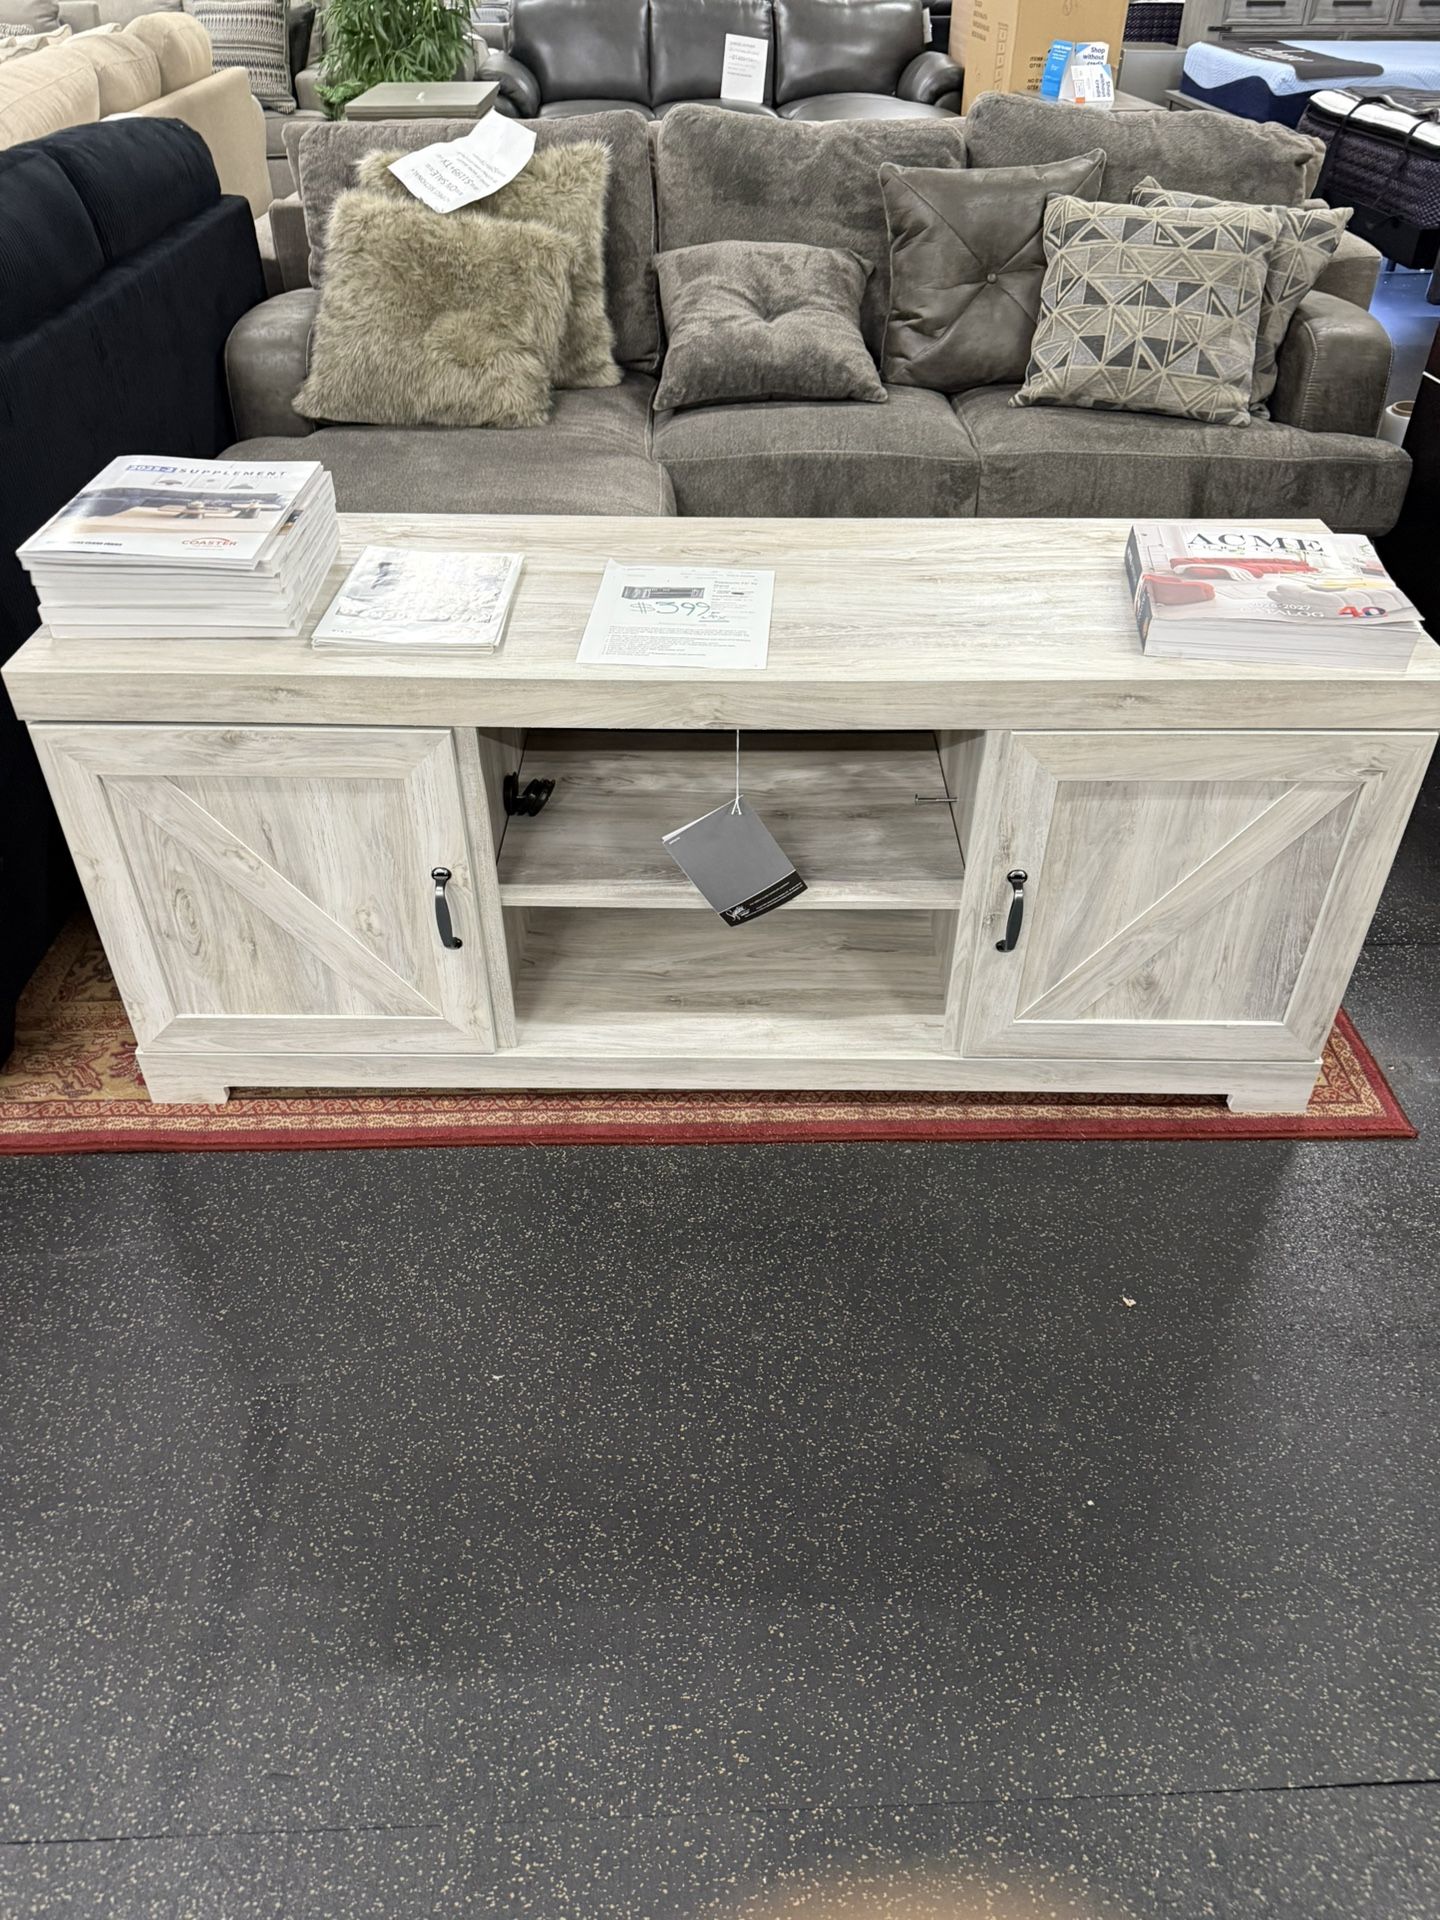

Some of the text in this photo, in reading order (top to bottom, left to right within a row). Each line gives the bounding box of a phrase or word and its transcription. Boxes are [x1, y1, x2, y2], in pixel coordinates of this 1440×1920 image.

[1091, 46, 1106, 55] Shop
[179, 467, 287, 477] SUPPLEMENT
[1187, 532, 1325, 552] ACME
[630, 601, 711, 616] $399
[1240, 607, 1325, 618] CATALOG
